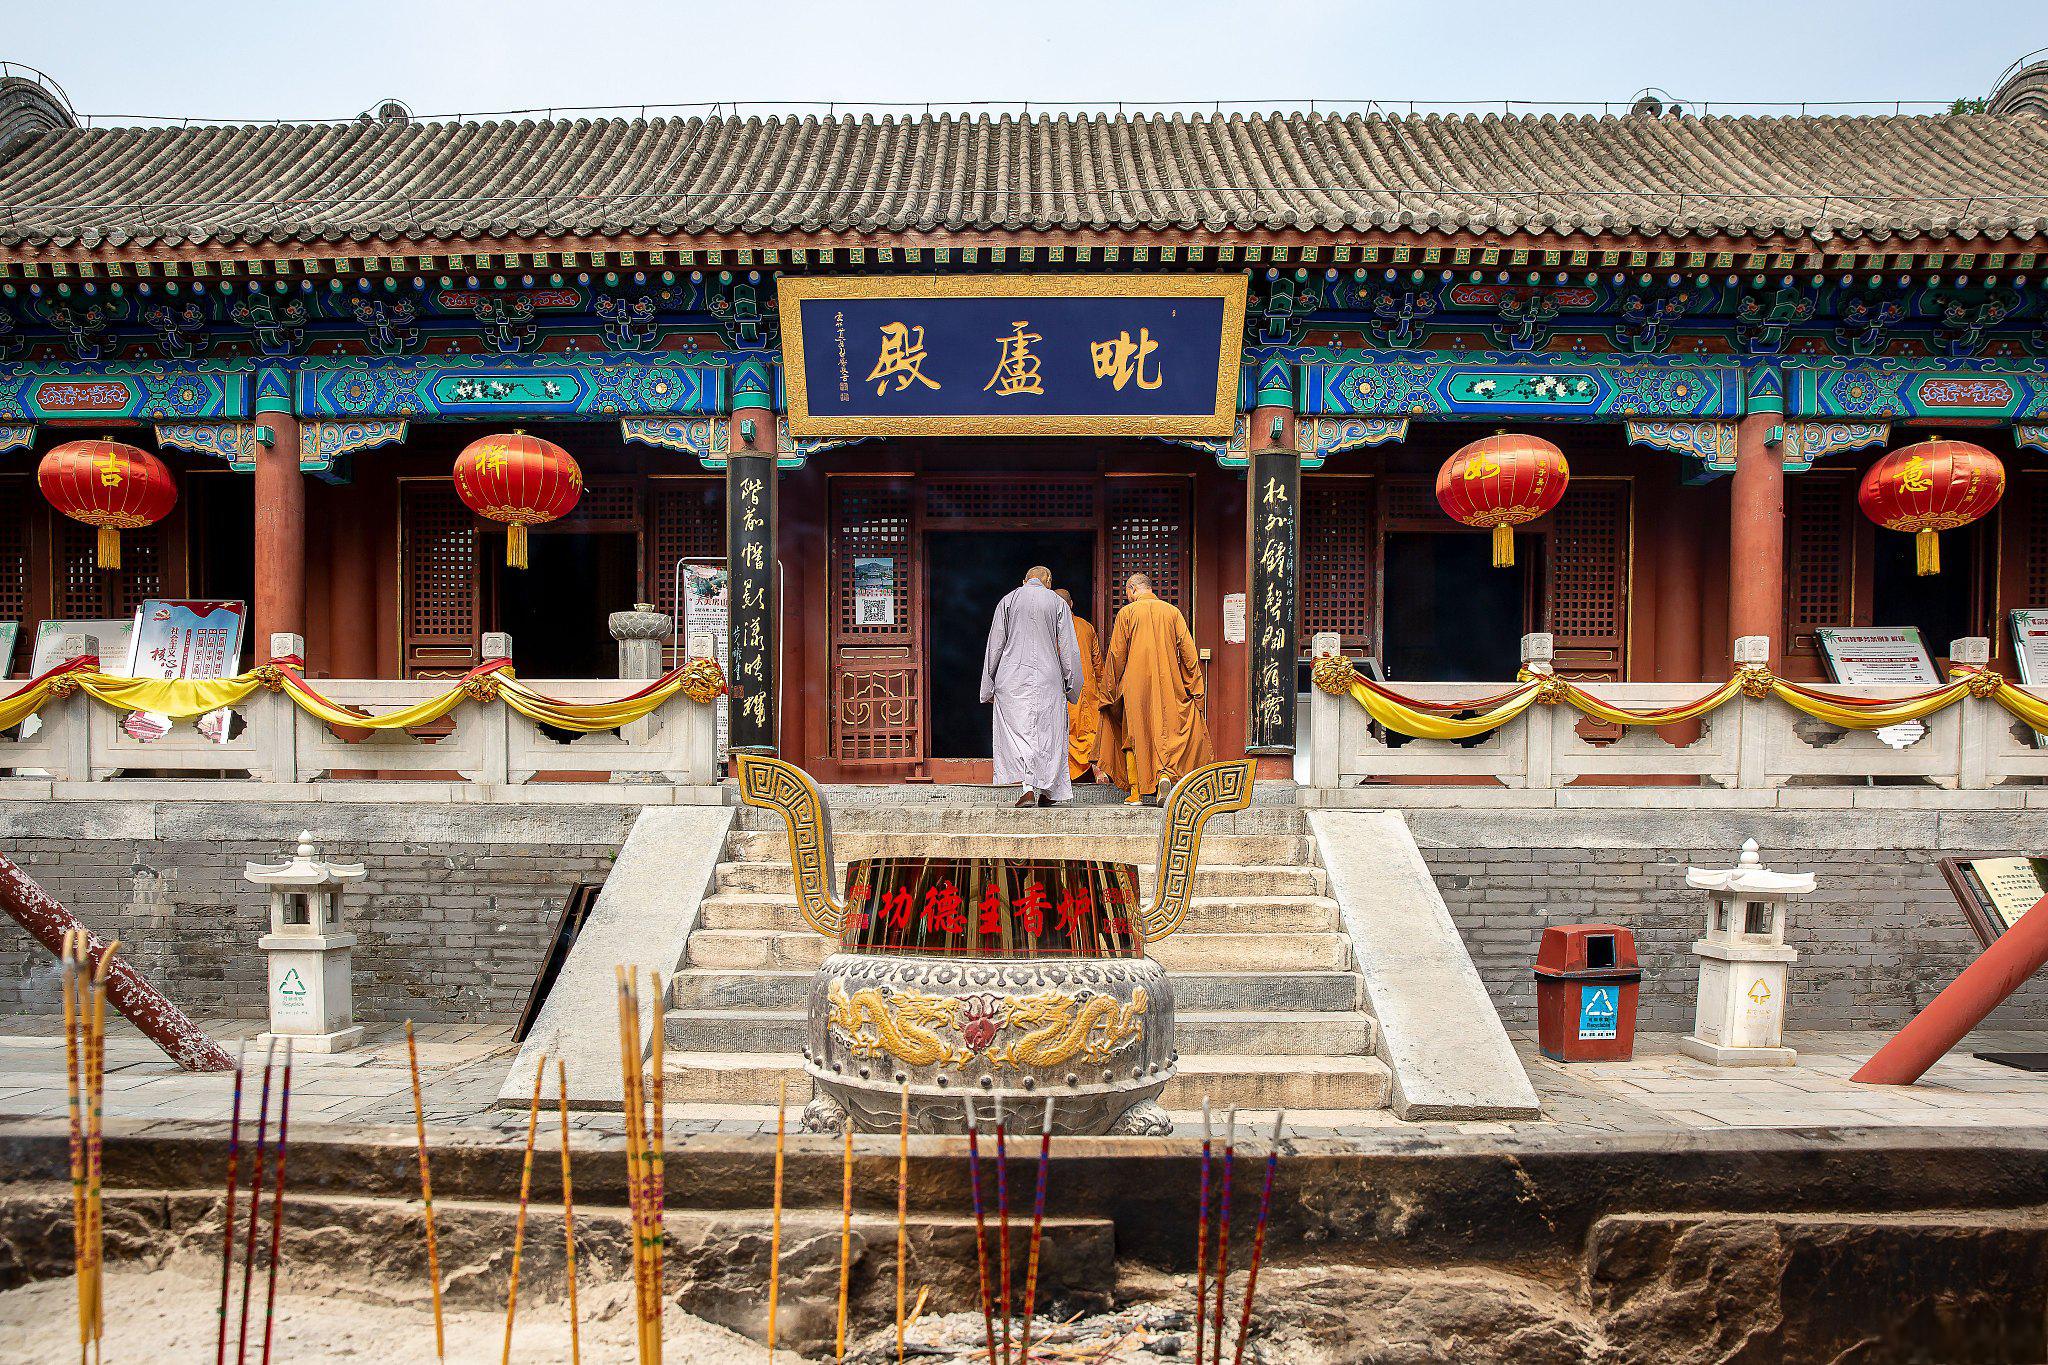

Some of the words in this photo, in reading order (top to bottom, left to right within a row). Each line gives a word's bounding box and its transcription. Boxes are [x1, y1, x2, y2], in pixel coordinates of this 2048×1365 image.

[92, 452, 130, 487] 吉
[474, 444, 508, 480] 祥
[1463, 450, 1500, 480] 如
[1893, 455, 1933, 494] 意
